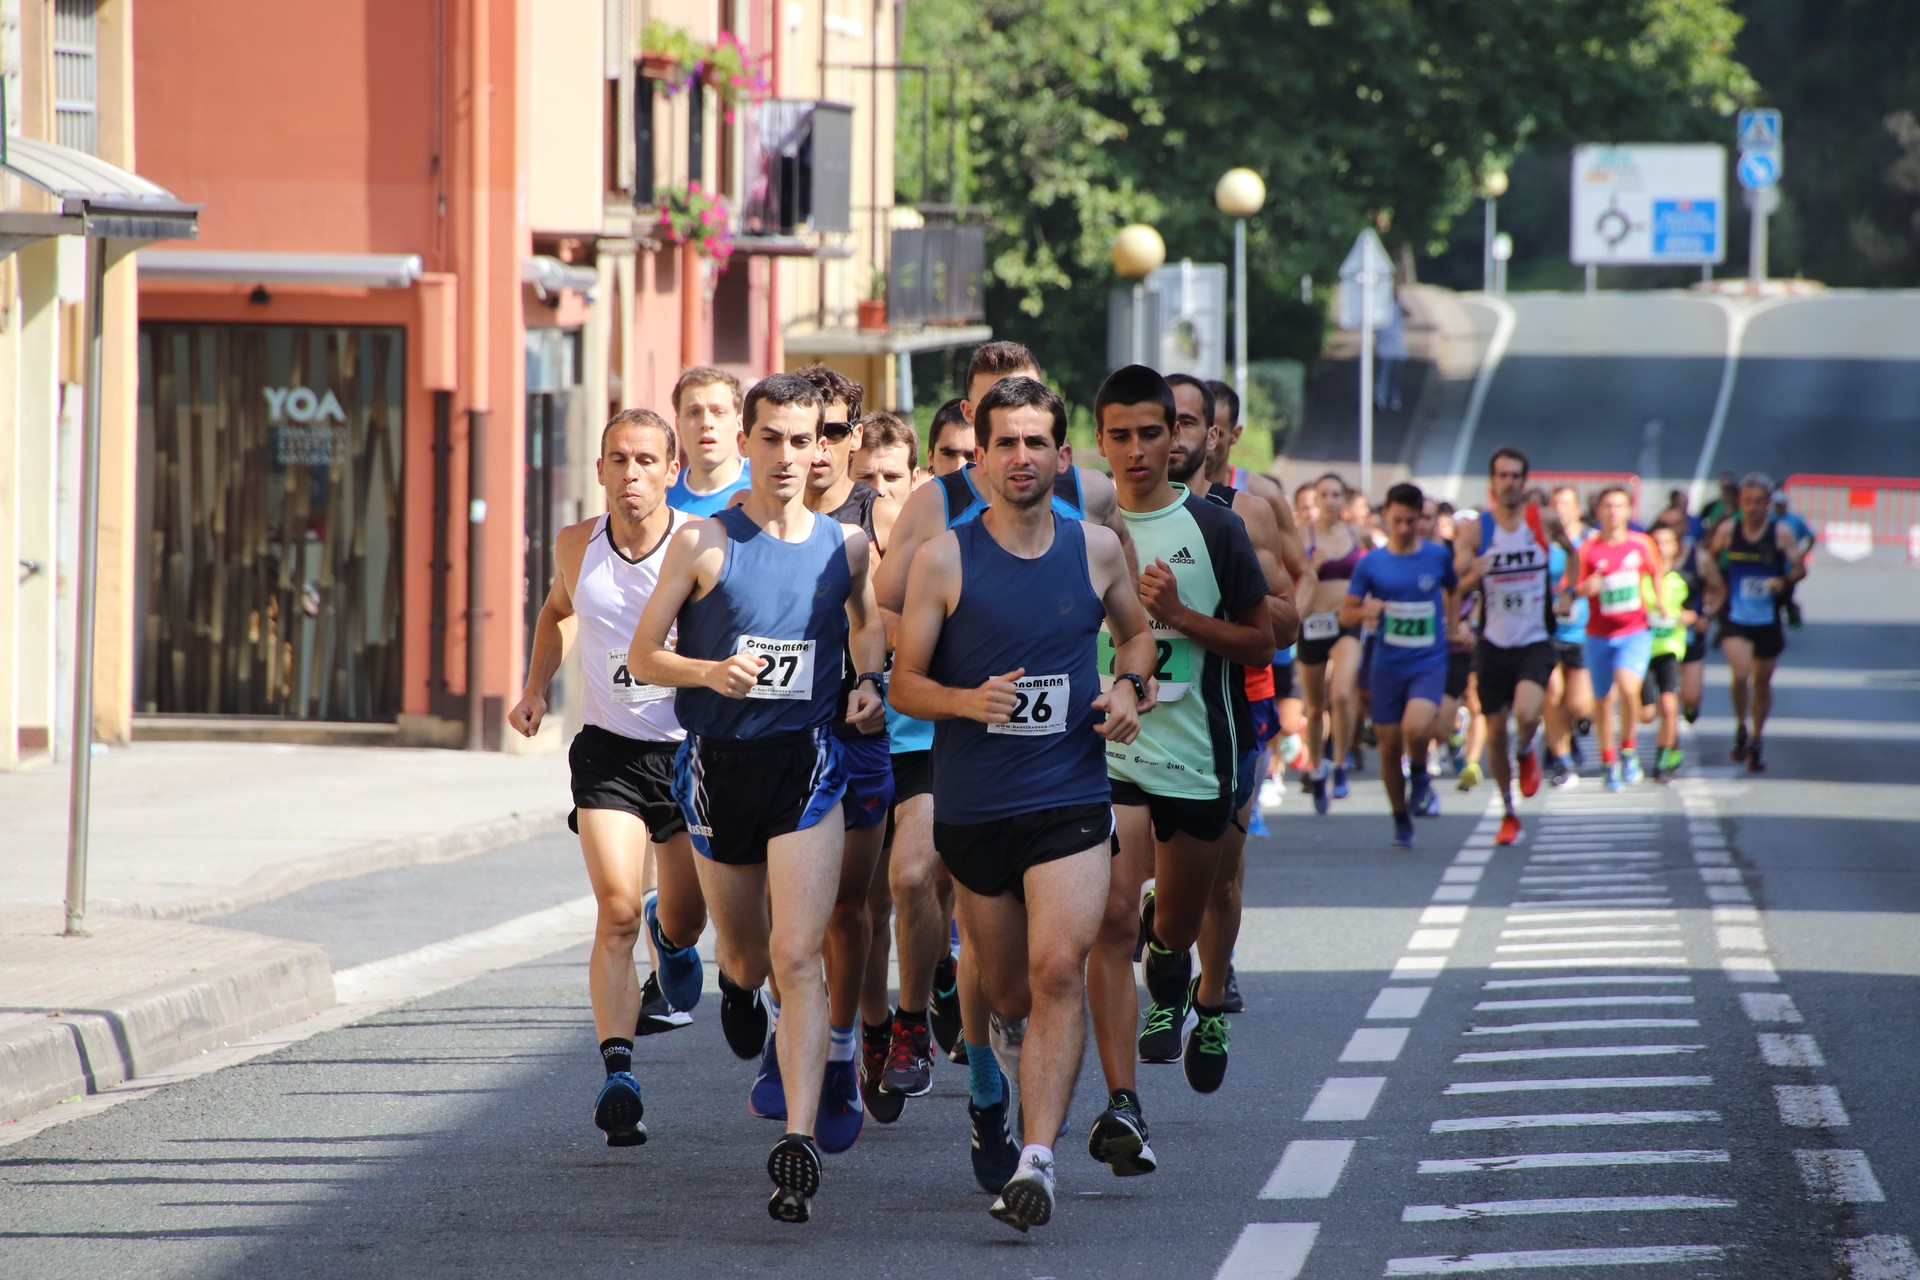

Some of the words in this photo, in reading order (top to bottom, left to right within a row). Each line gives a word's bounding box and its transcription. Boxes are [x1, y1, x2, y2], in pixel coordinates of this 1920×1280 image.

[263, 386, 346, 422] YOA
[1169, 556, 1196, 565] adidas
[756, 654, 798, 687] 27
[1009, 691, 1052, 723] 26
